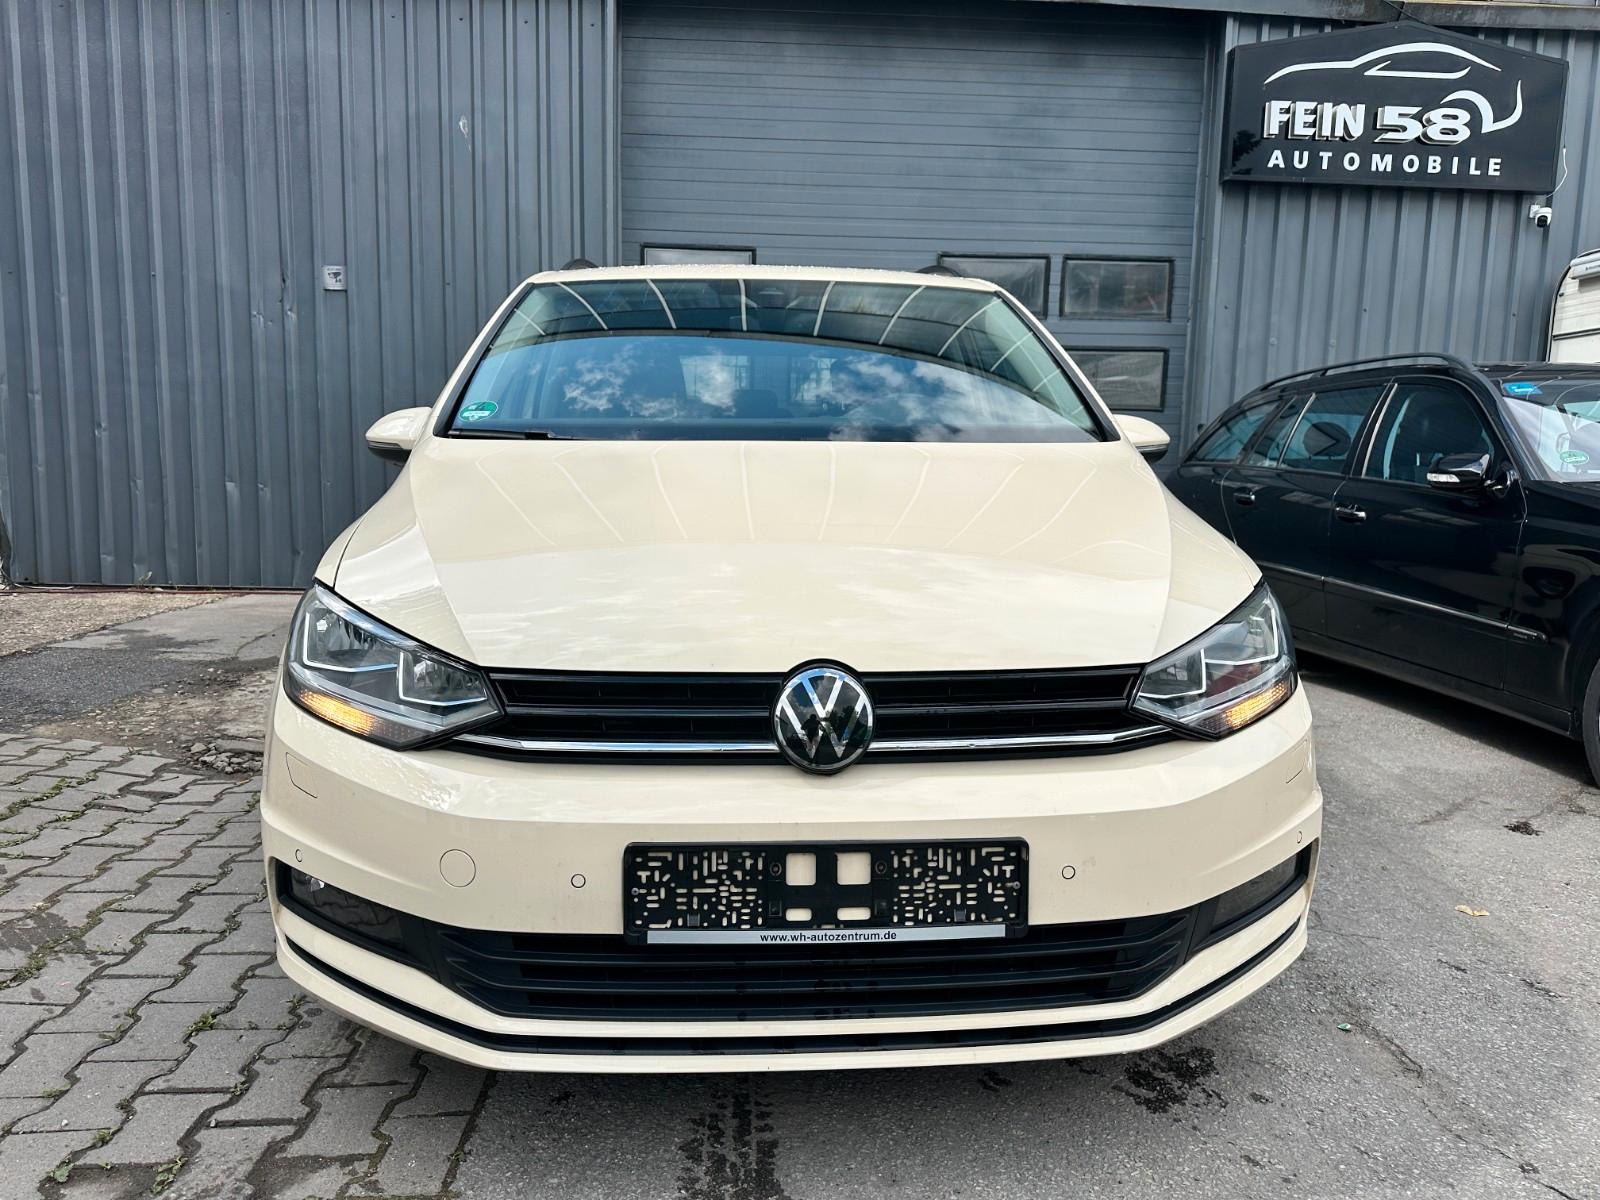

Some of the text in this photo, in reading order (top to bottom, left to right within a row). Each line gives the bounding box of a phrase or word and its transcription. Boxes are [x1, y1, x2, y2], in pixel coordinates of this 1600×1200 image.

[1264, 100, 1471, 146] FEIN 58
[1267, 149, 1502, 176] AUTOMOBILE
[775, 667, 873, 770] VW
[759, 930, 897, 942] www.wh-autozentrum.de
